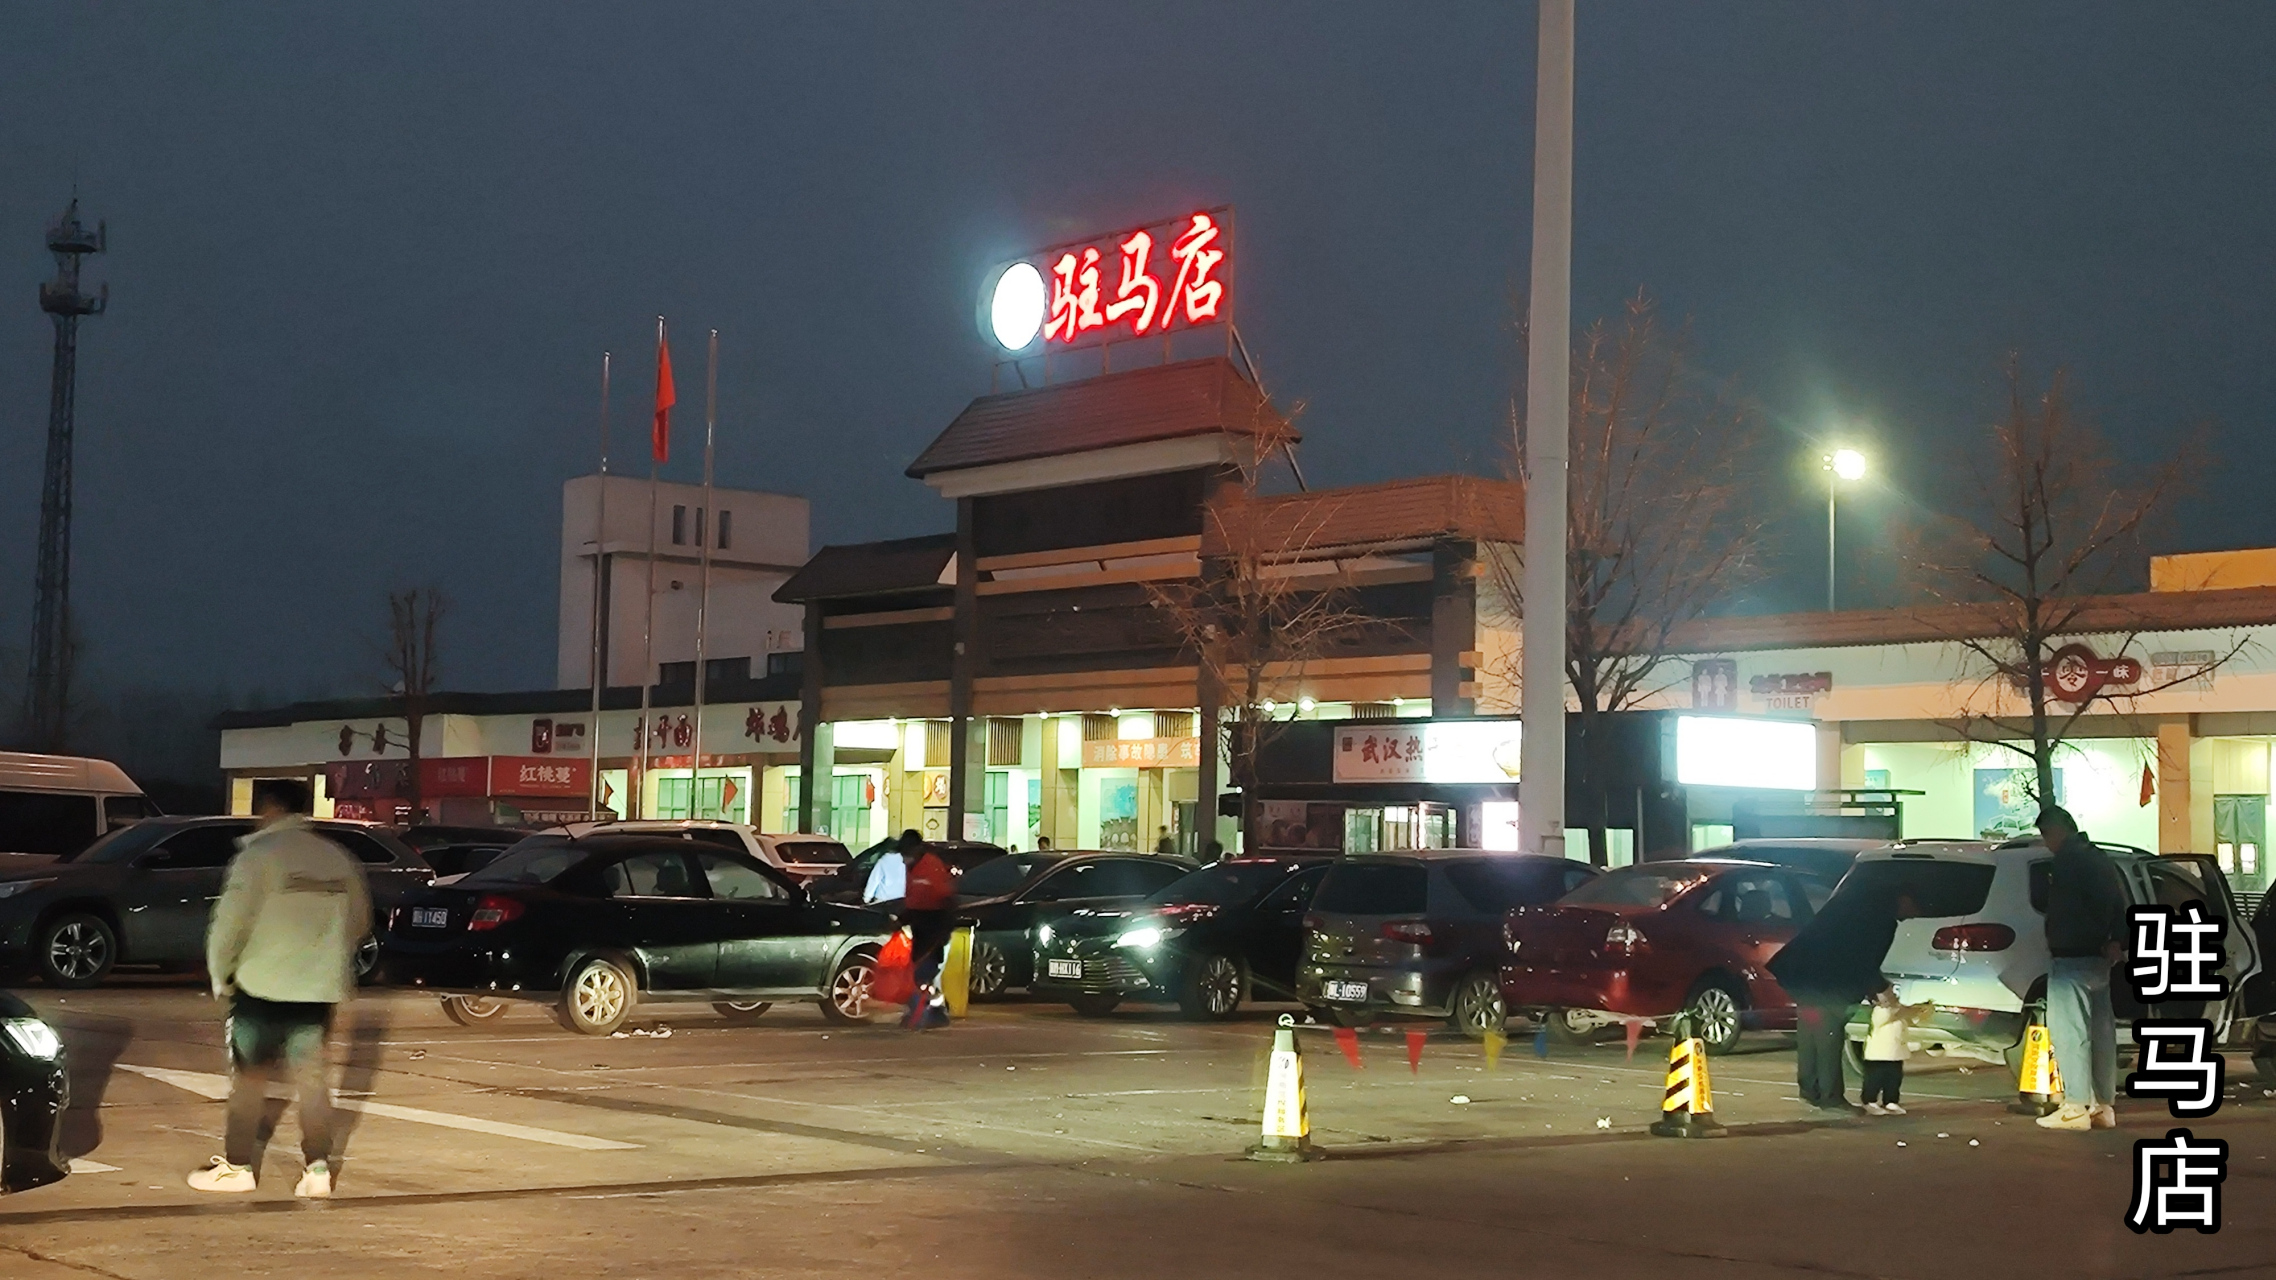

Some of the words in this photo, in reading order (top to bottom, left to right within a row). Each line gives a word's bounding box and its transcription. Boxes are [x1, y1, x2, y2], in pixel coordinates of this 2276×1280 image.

[1043, 212, 1225, 343] 驻马店
[1766, 696, 1810, 710] TOILET
[745, 705, 801, 744] 炸鸡
[1361, 735, 1438, 763] 武汉热
